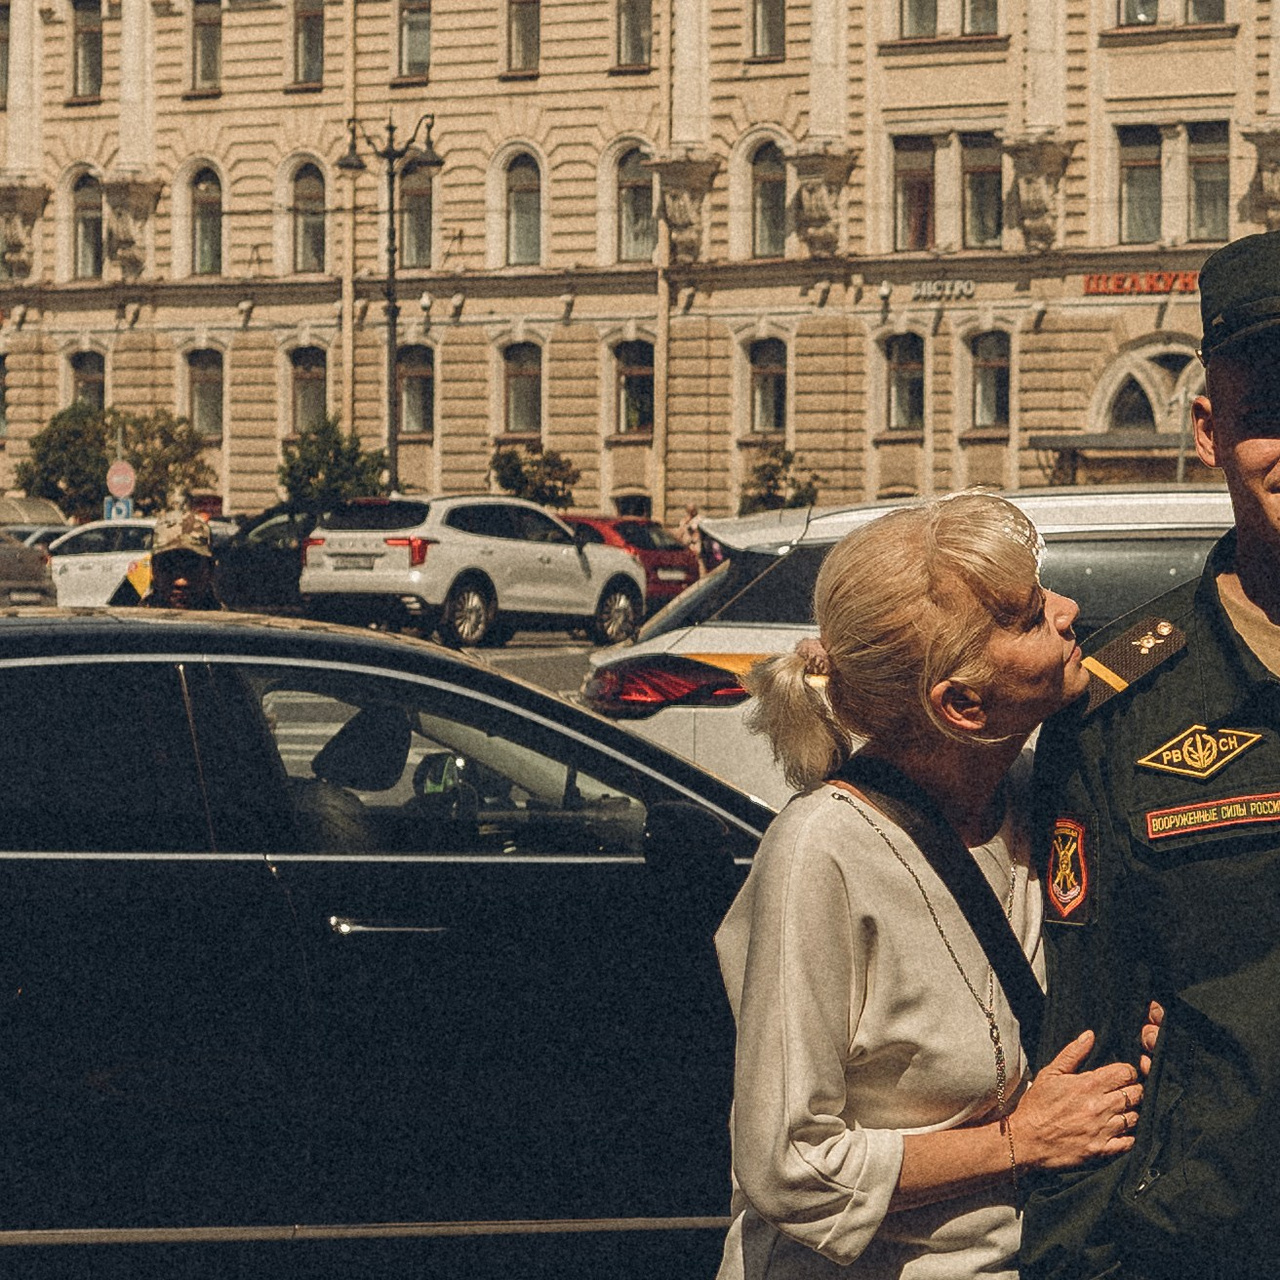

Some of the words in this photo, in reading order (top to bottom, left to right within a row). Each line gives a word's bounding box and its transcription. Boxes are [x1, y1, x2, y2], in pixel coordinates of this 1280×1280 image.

[1083, 271, 1199, 293] ЩЕЛКУН
[1162, 748, 1182, 765] РВ
[1218, 735, 1239, 751] СН
[1151, 807, 1219, 832] ВООРУЖЕННЫЕ
[1220, 802, 1248, 820] СИЛЫ
